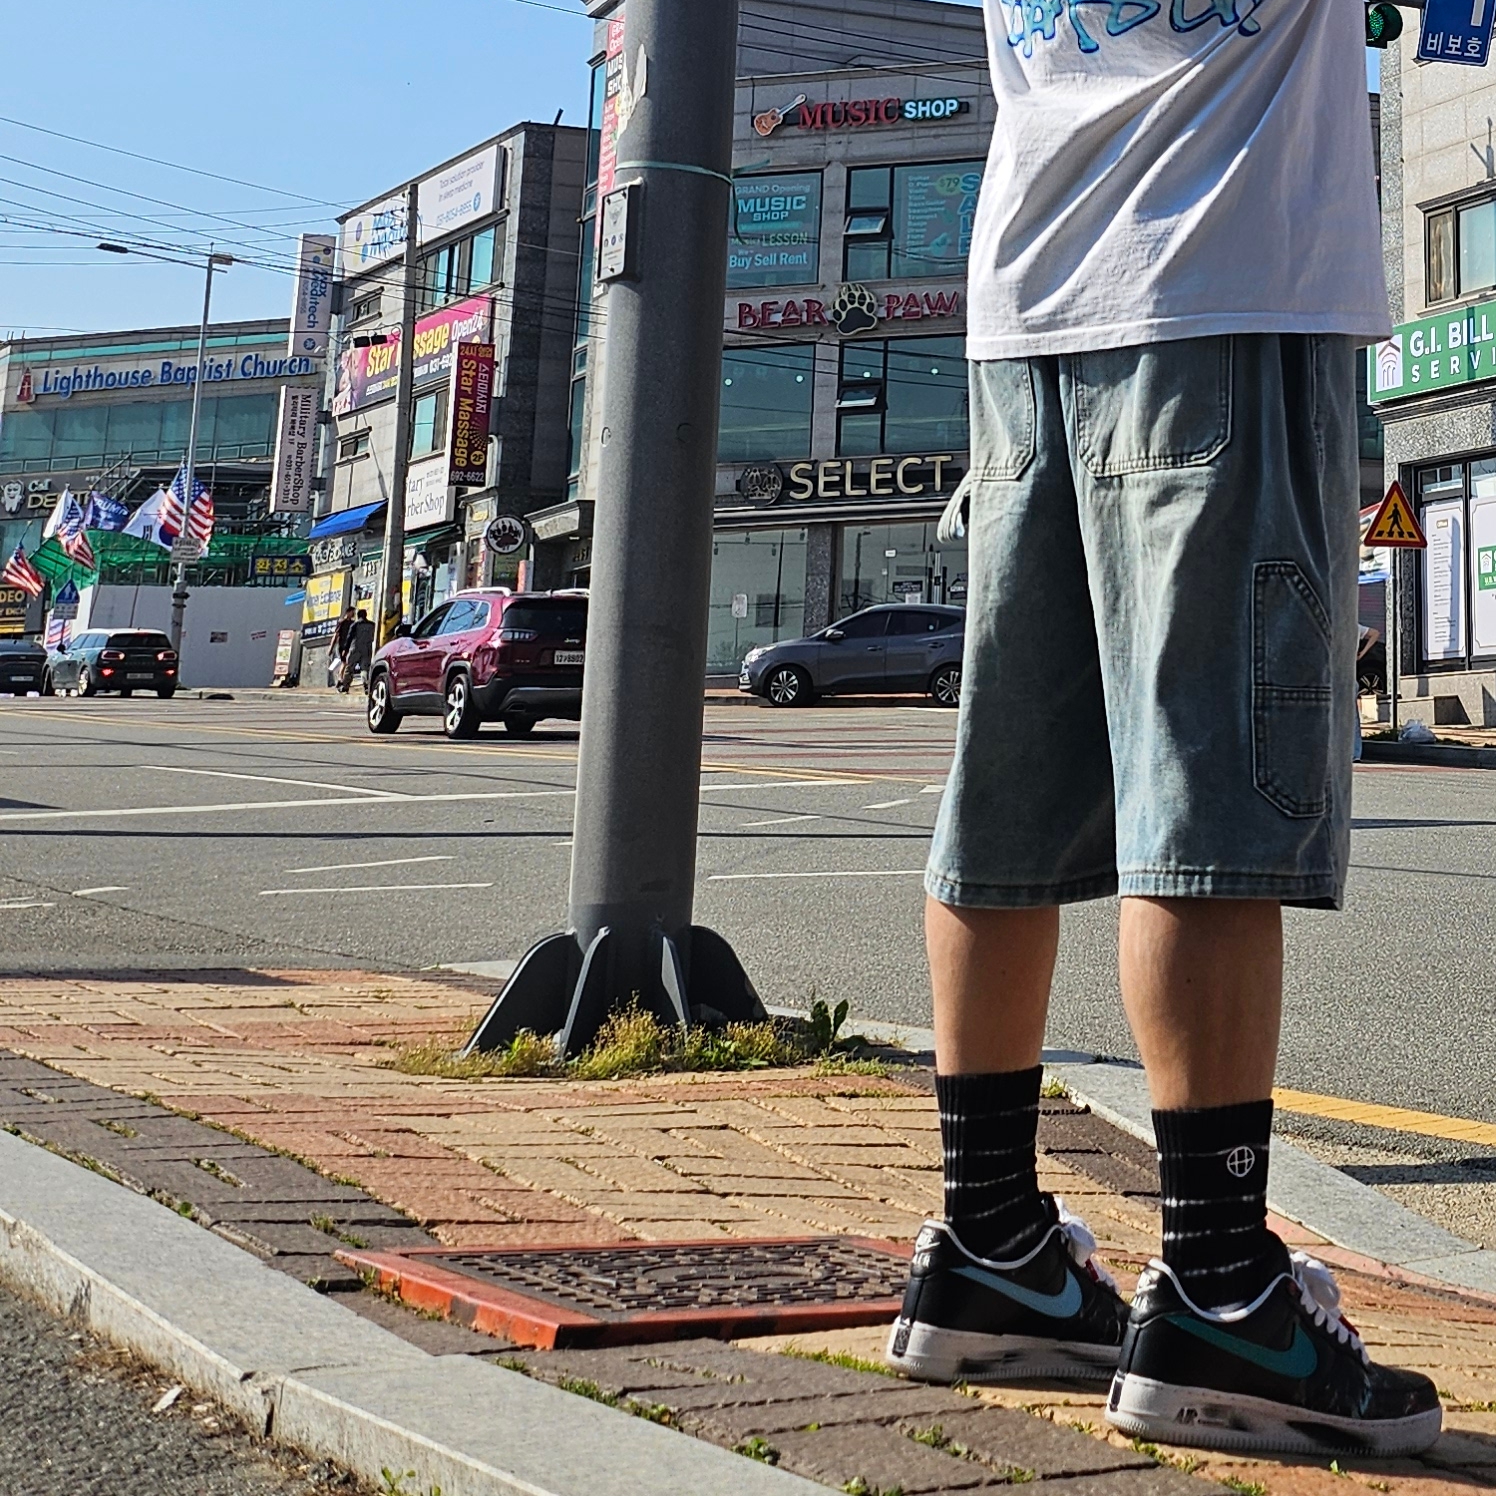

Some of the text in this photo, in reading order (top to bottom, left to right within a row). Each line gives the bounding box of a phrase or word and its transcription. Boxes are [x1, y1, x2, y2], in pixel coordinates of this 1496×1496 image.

[1426, 31, 1482, 58] 비보호
[799, 97, 959, 129] MUSIC SHOP
[735, 185, 770, 196] GRAND
[738, 196, 807, 213] MUSIC
[753, 211, 789, 221] SHOP
[762, 232, 808, 247] LESSON
[729, 252, 807, 270] Buy Sell Rent
[738, 291, 959, 328] BEAR PAW
[1410, 326, 1442, 357] G.I.
[1448, 315, 1493, 349] BILL
[43, 367, 152, 398] Lighthouse
[240, 353, 310, 377] Church
[366, 346, 395, 378] Star
[455, 359, 477, 467] Star Massage
[290, 394, 312, 505] Military BarberShop
[473, 454, 483, 462] 2F
[451, 470, 485, 482] 692-6622
[789, 455, 952, 500] SELECT
